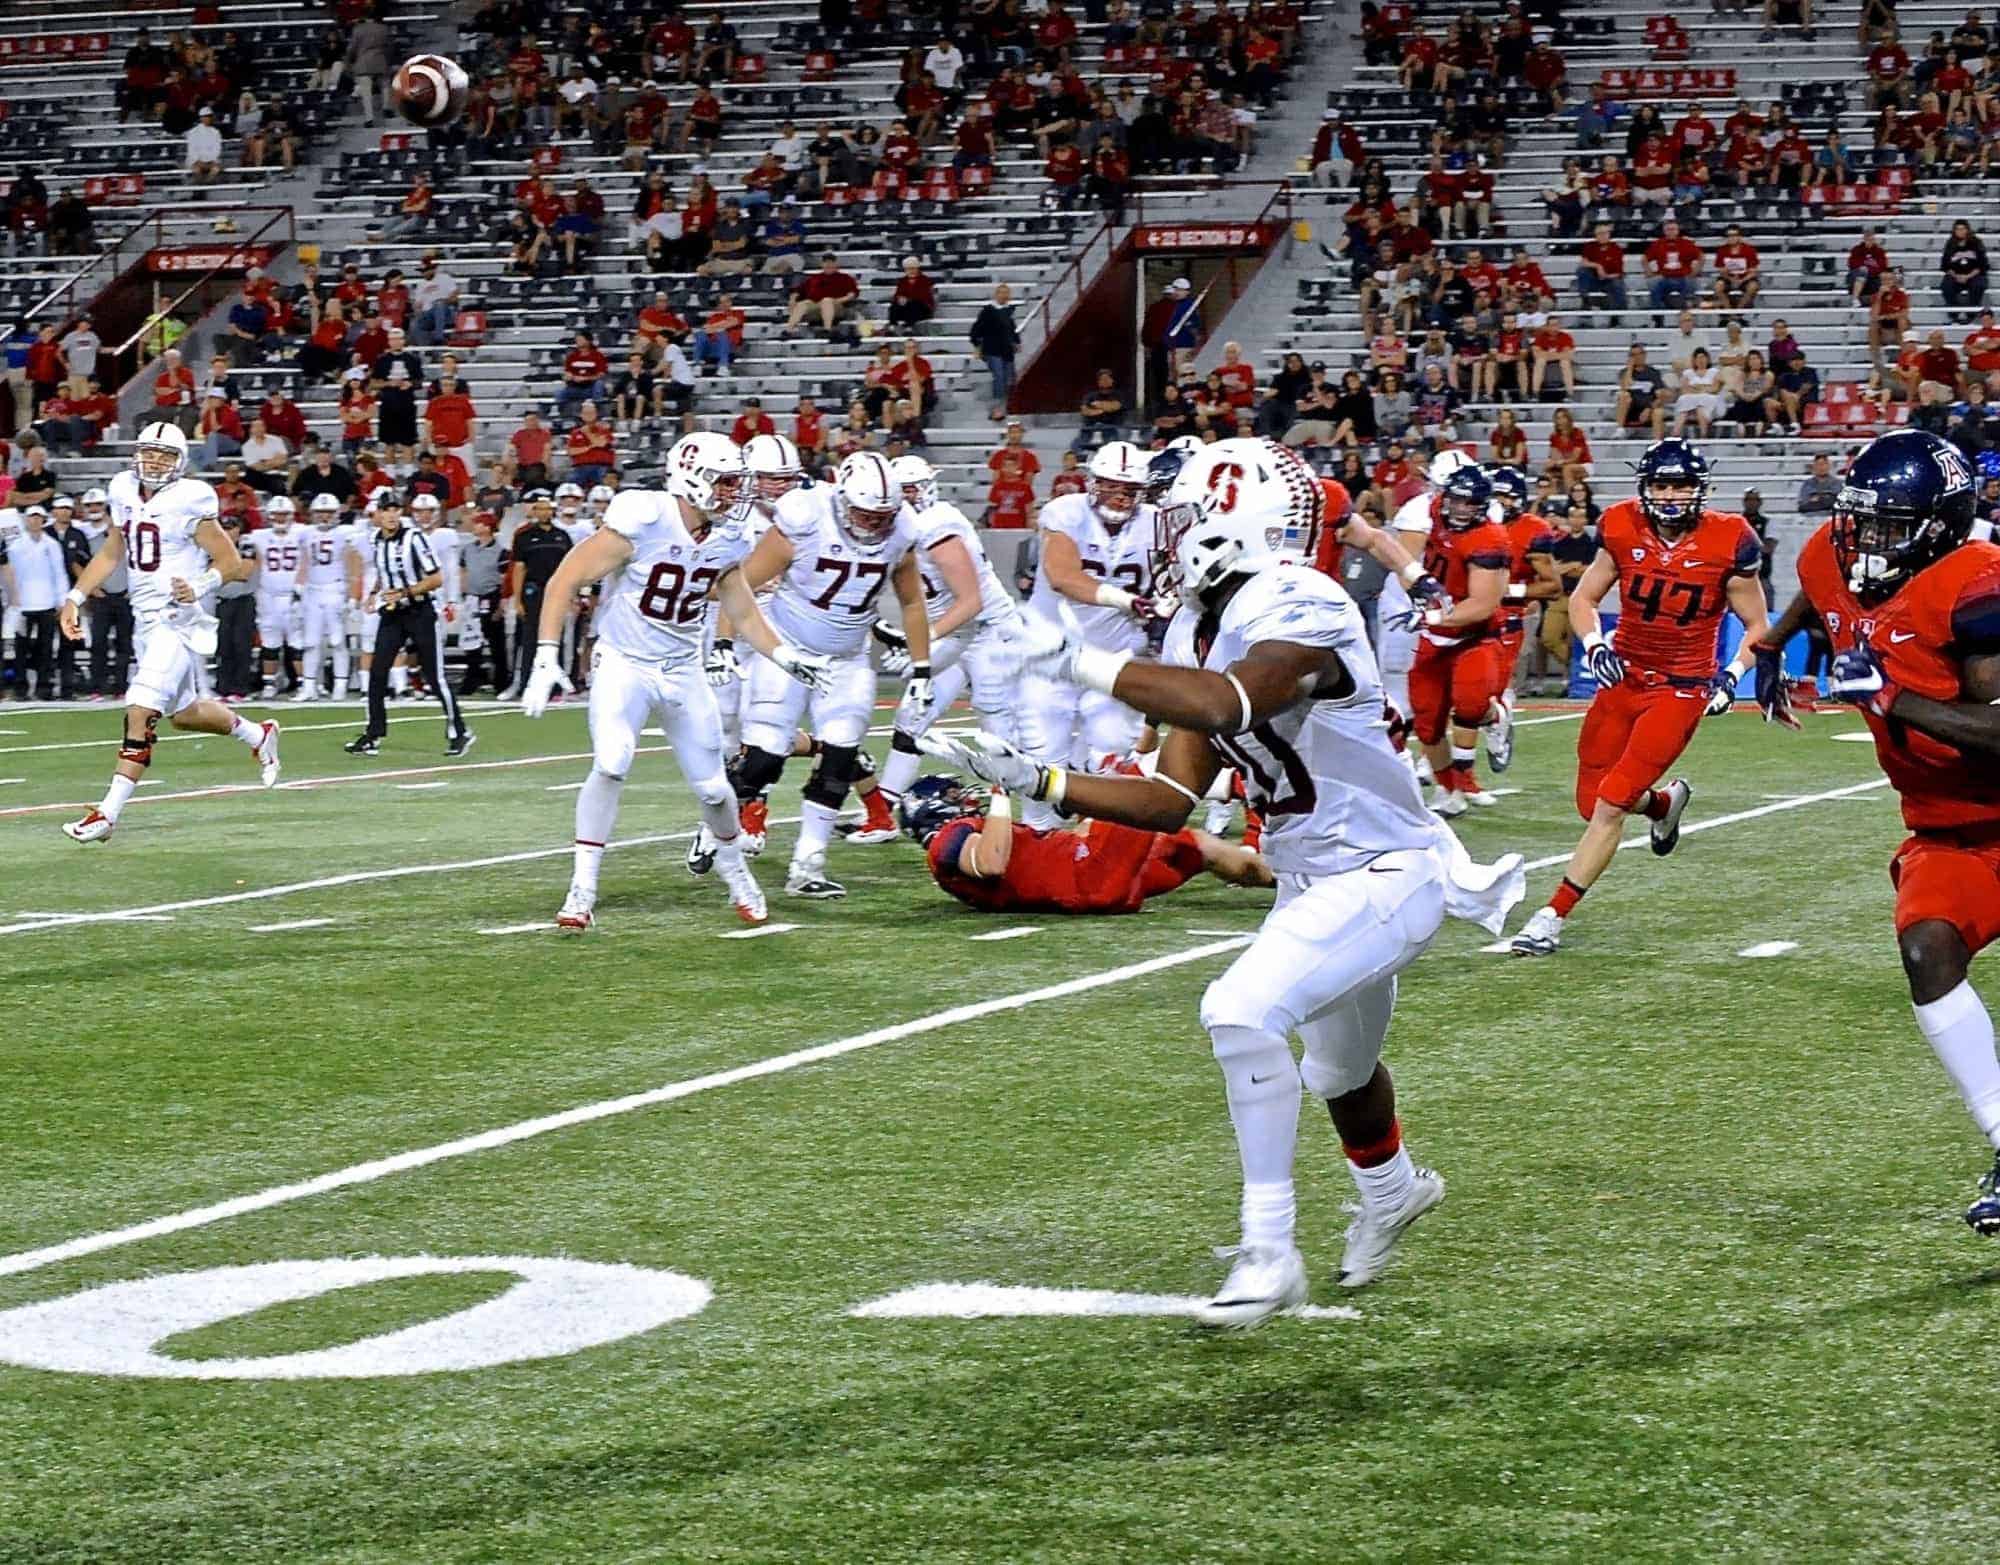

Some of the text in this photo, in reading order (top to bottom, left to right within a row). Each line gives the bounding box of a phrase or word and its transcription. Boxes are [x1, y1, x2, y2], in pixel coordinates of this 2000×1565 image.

[1931, 447, 1972, 497] A
[121, 519, 161, 573] 10
[266, 546, 298, 572] 65
[638, 561, 721, 624] 82
[808, 557, 888, 615] 77
[1628, 573, 1705, 627] 47
